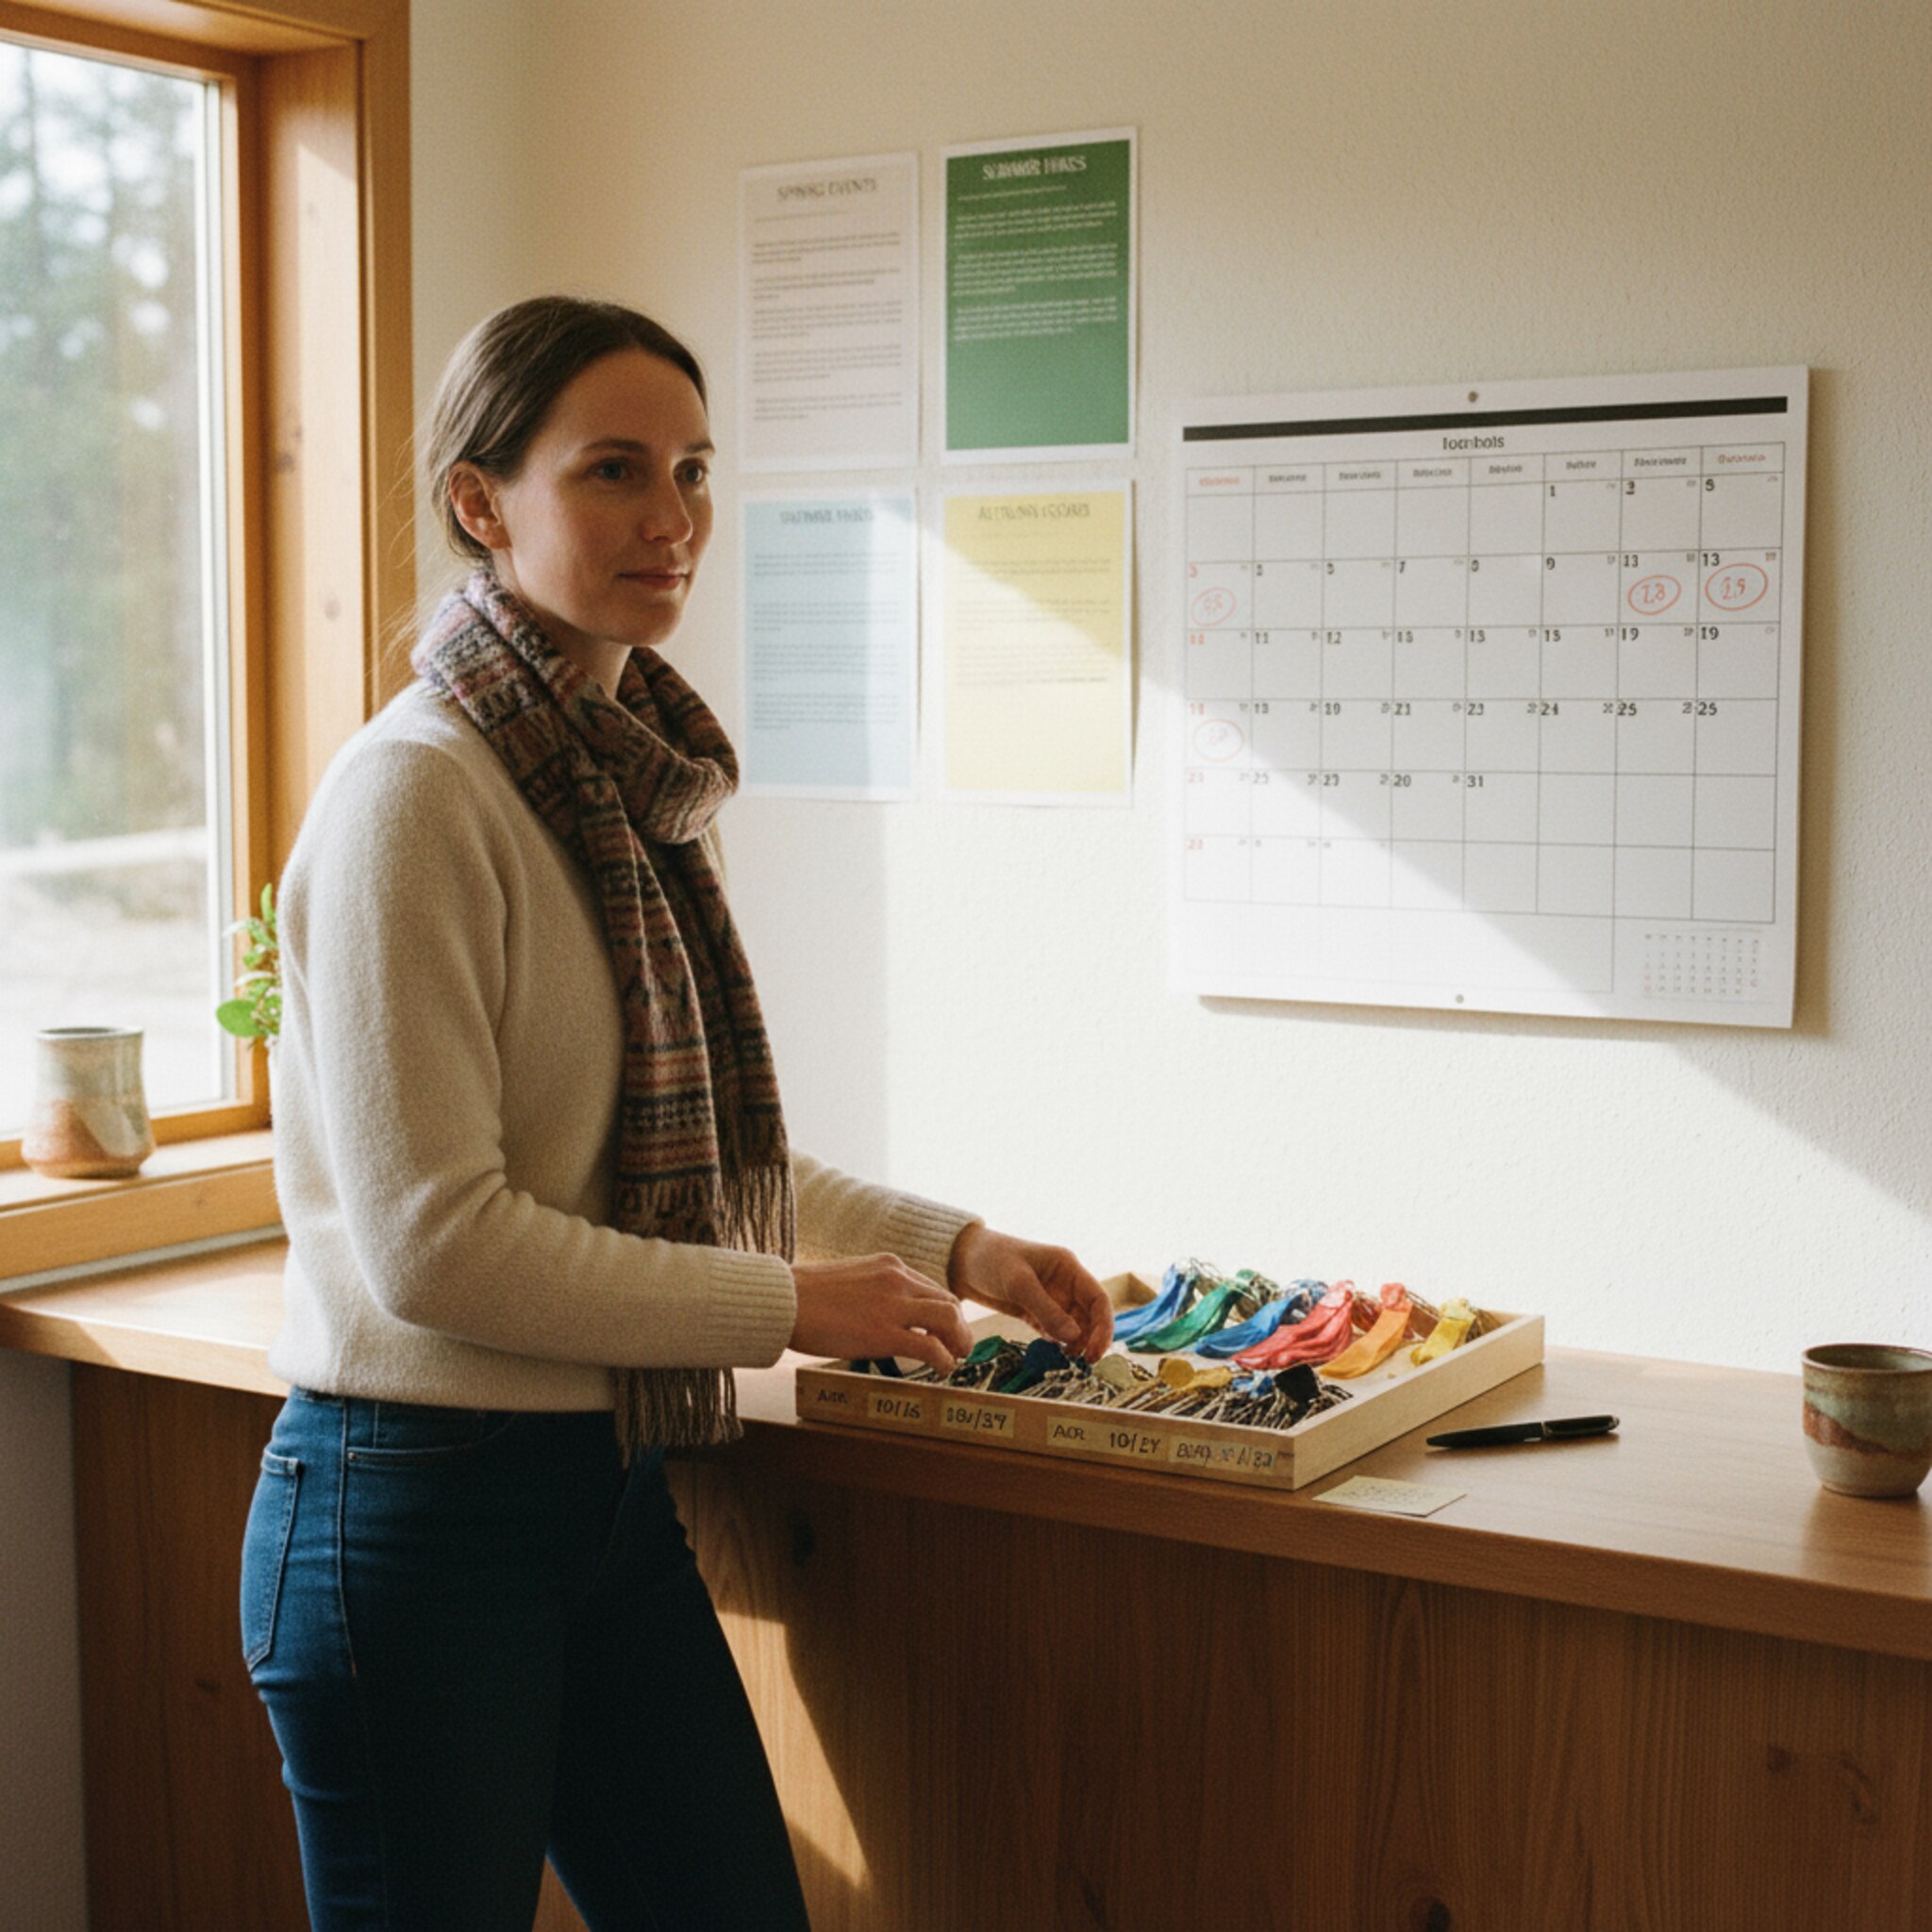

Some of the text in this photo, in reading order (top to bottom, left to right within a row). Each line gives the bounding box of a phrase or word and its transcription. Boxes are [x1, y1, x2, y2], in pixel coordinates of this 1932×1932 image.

[1702, 553, 1720, 567] 13
[1622, 627, 1640, 641] 19
[1700, 626, 1719, 641] 19
[1697, 702, 1717, 716] 25
[1467, 774, 1484, 787] 31
